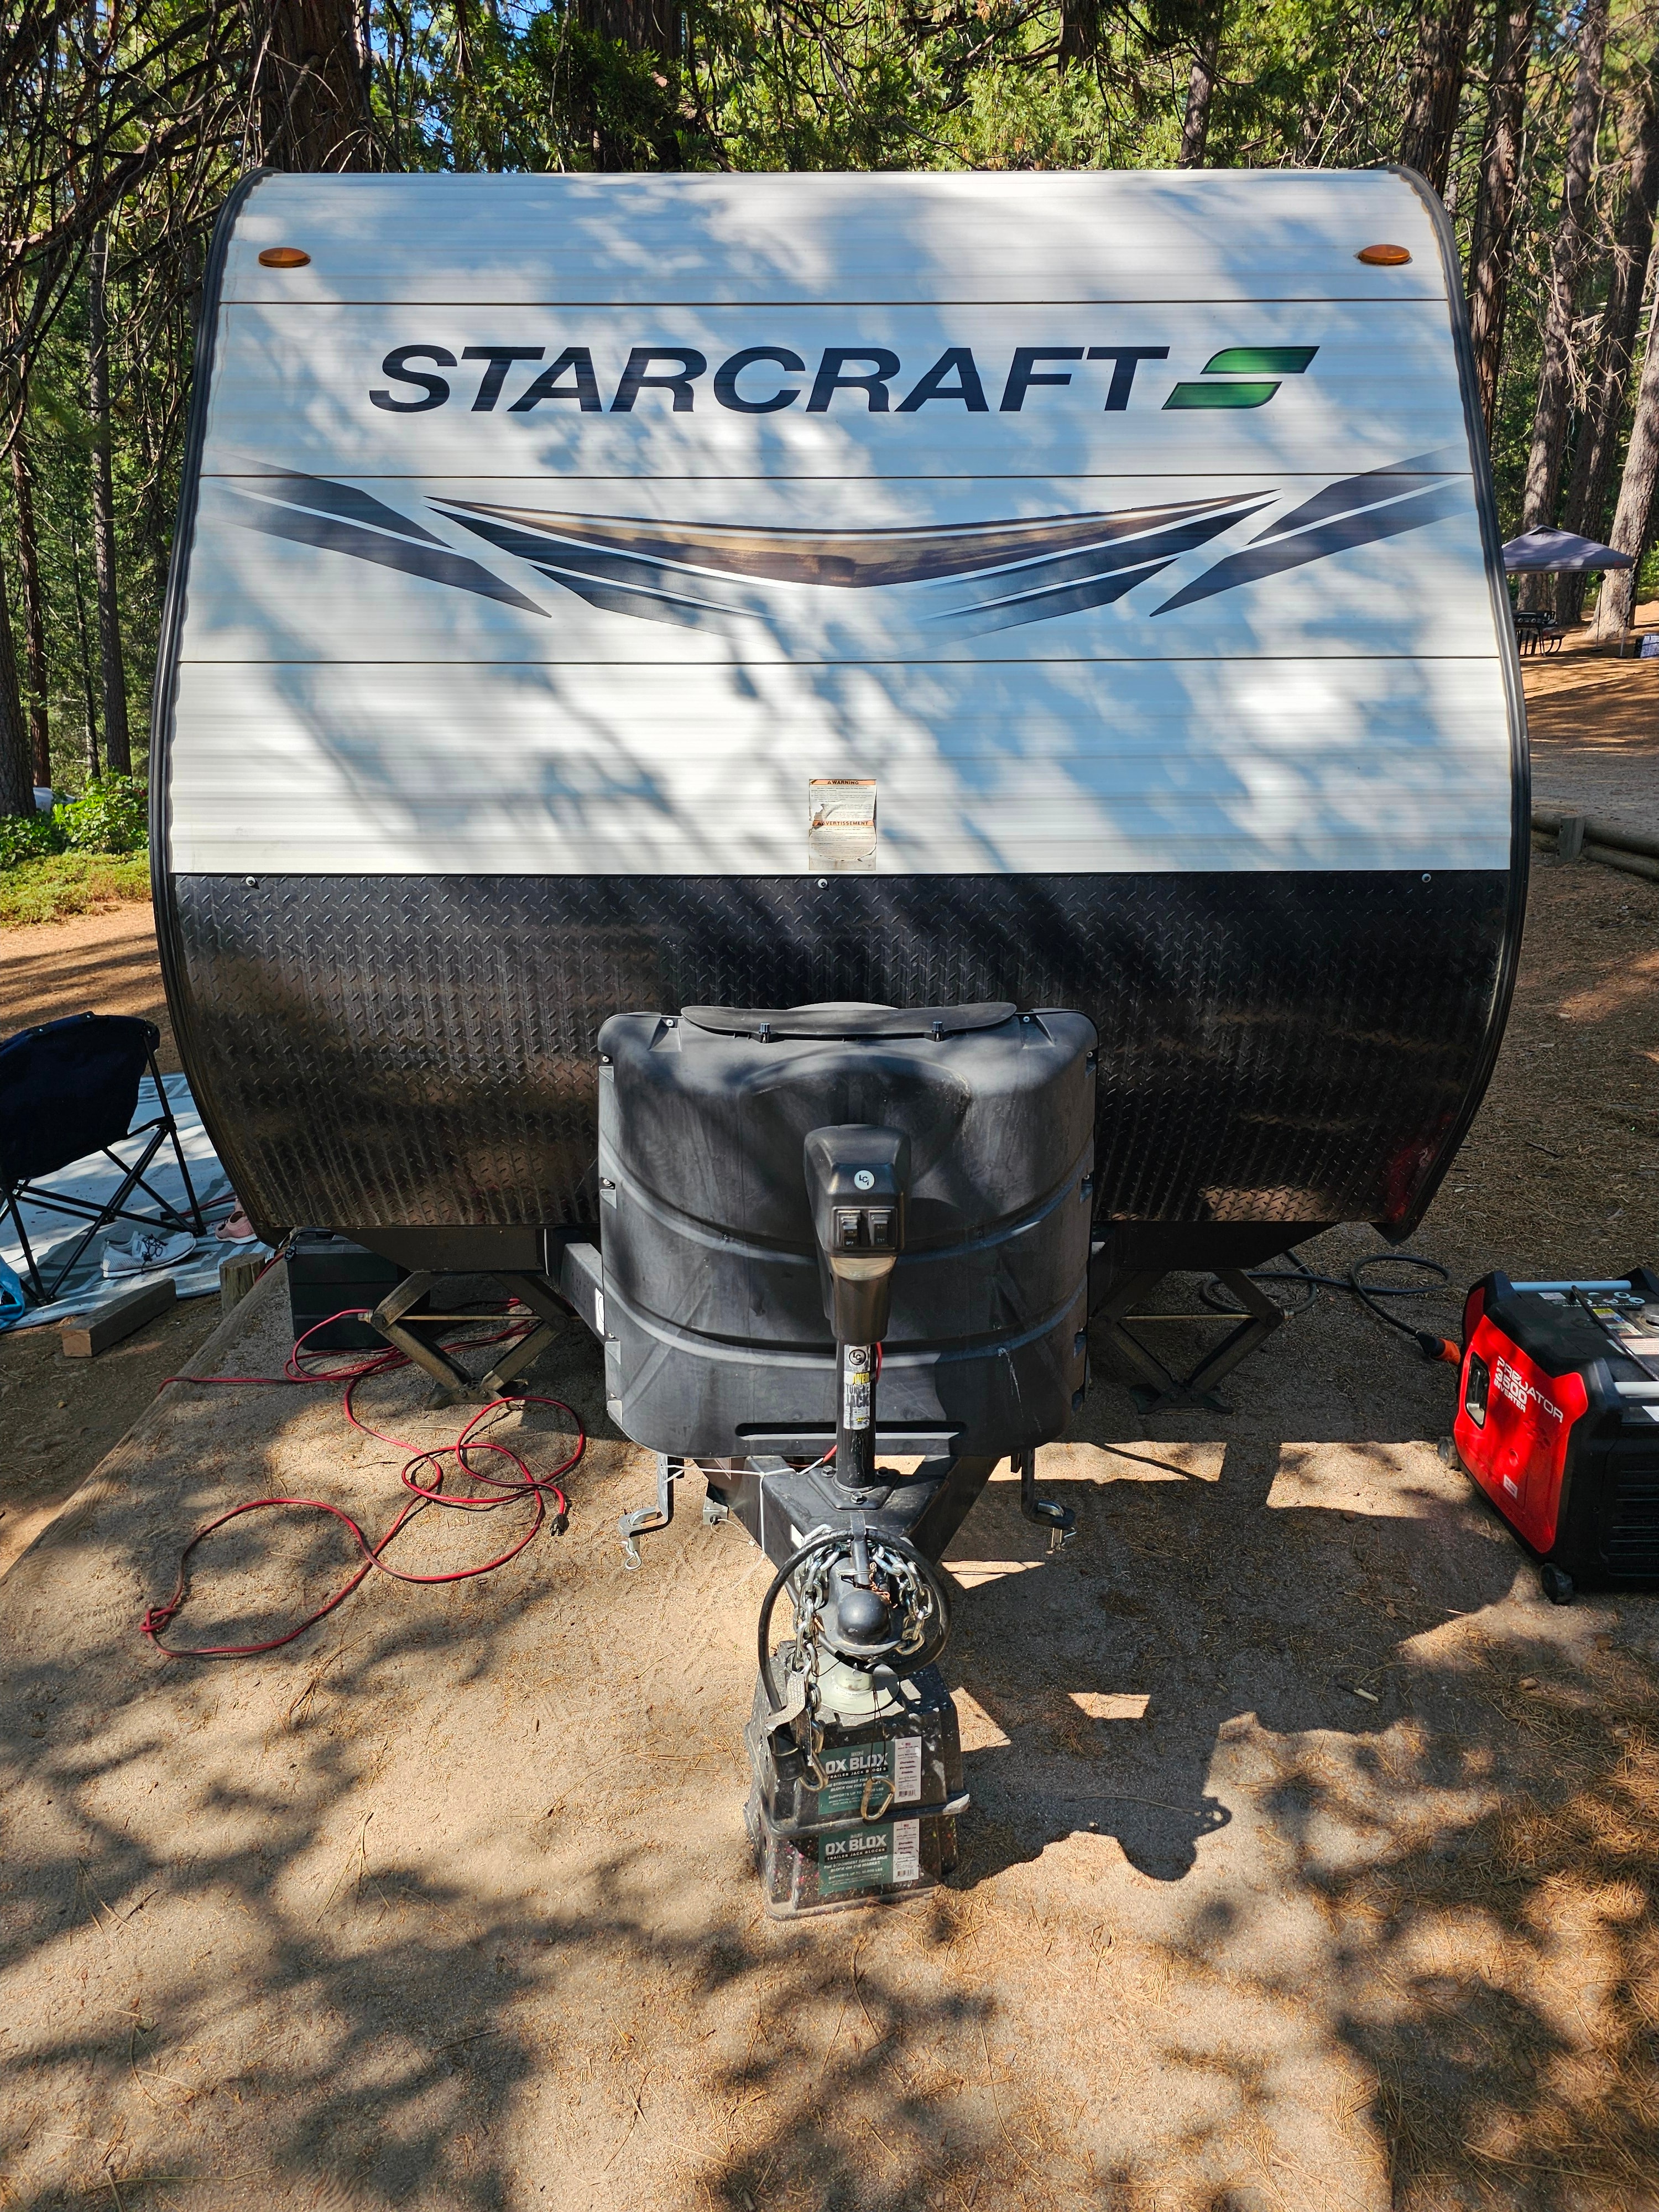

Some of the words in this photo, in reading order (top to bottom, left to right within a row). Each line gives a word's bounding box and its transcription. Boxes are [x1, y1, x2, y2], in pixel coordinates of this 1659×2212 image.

[369, 344, 1170, 413] STARCRAFT
[859, 1175, 869, 1186] LCI
[1494, 1378, 1526, 1413] INVERTER
[1495, 1366, 1527, 1405] 3500
[1497, 1355, 1564, 1424] PREDATOR
[825, 1759, 847, 1774] OX
[849, 1752, 888, 1770] BLOX
[825, 1840, 846, 1856] OX
[849, 1834, 887, 1853] BLOX
